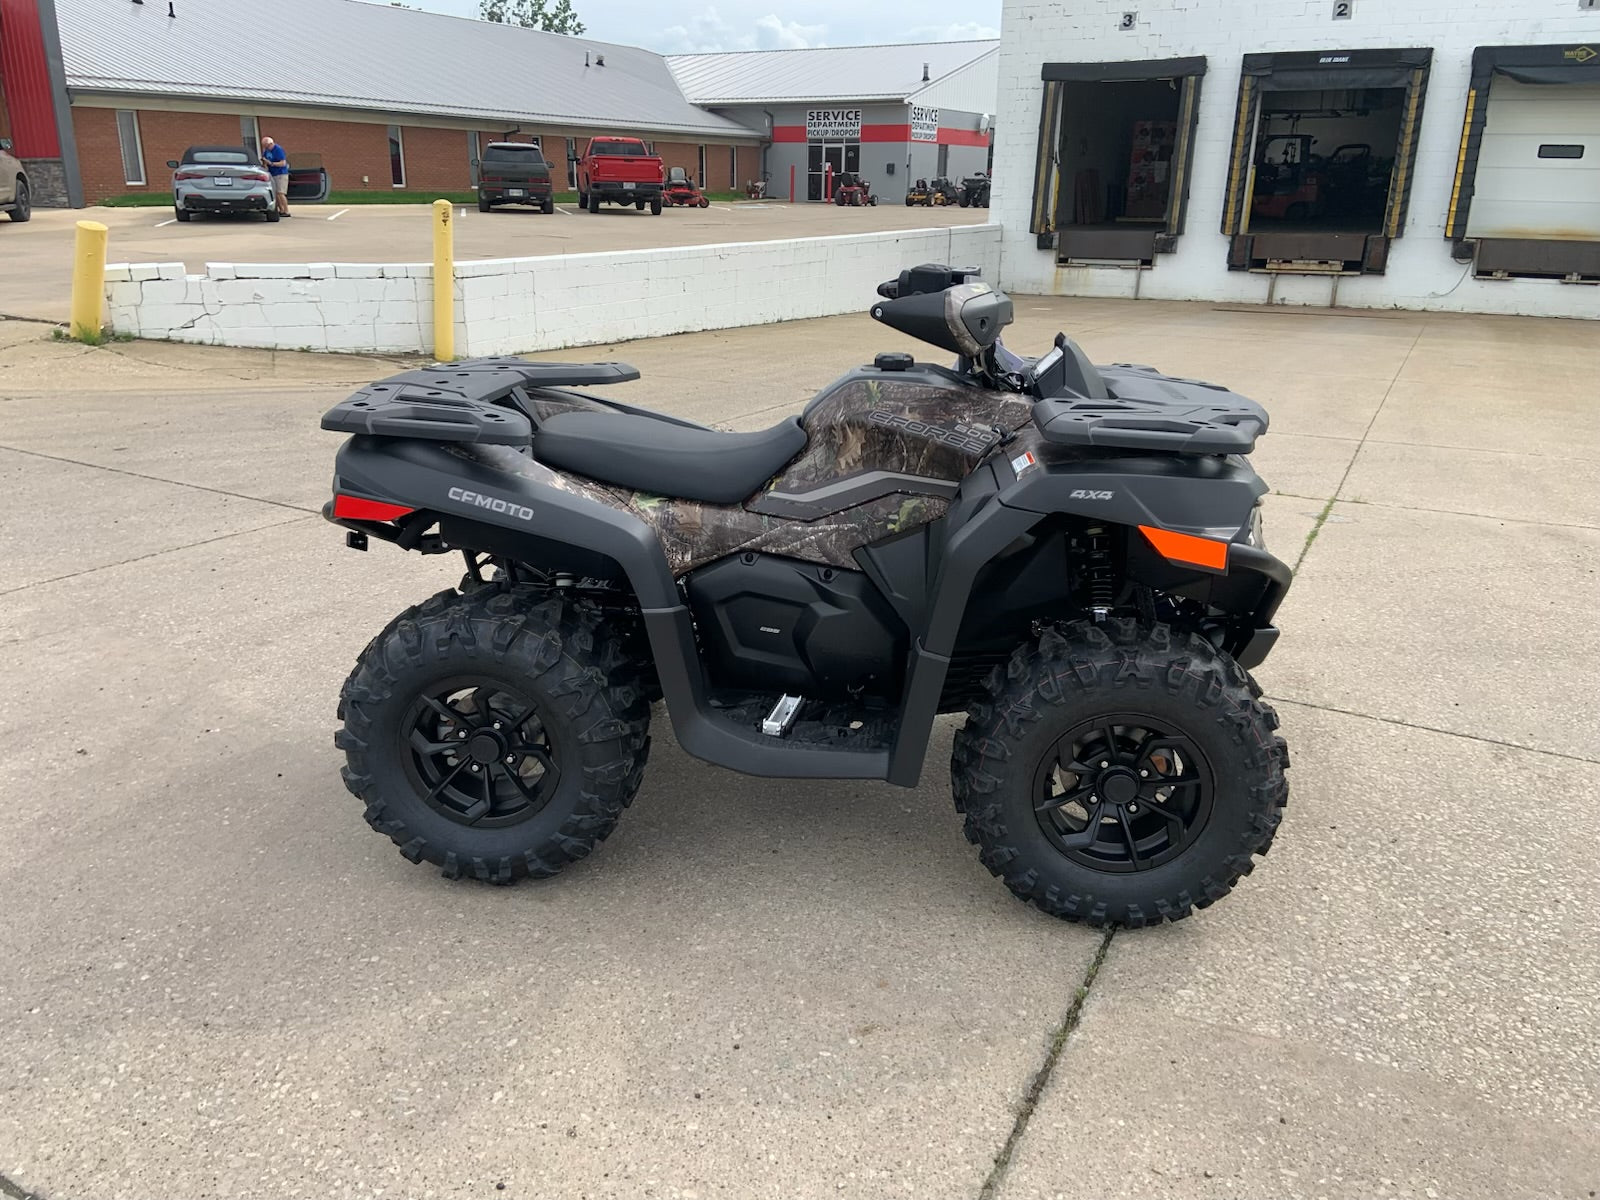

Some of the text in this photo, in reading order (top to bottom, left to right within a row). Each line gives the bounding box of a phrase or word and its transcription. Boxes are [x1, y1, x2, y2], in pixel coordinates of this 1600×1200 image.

[1336, 3, 1348, 16] 2
[1123, 14, 1133, 27] 3
[808, 110, 861, 121] SERVICE
[912, 106, 938, 122] SERVICE
[868, 410, 987, 454] CFORCE
[448, 486, 534, 520] CFMOTO
